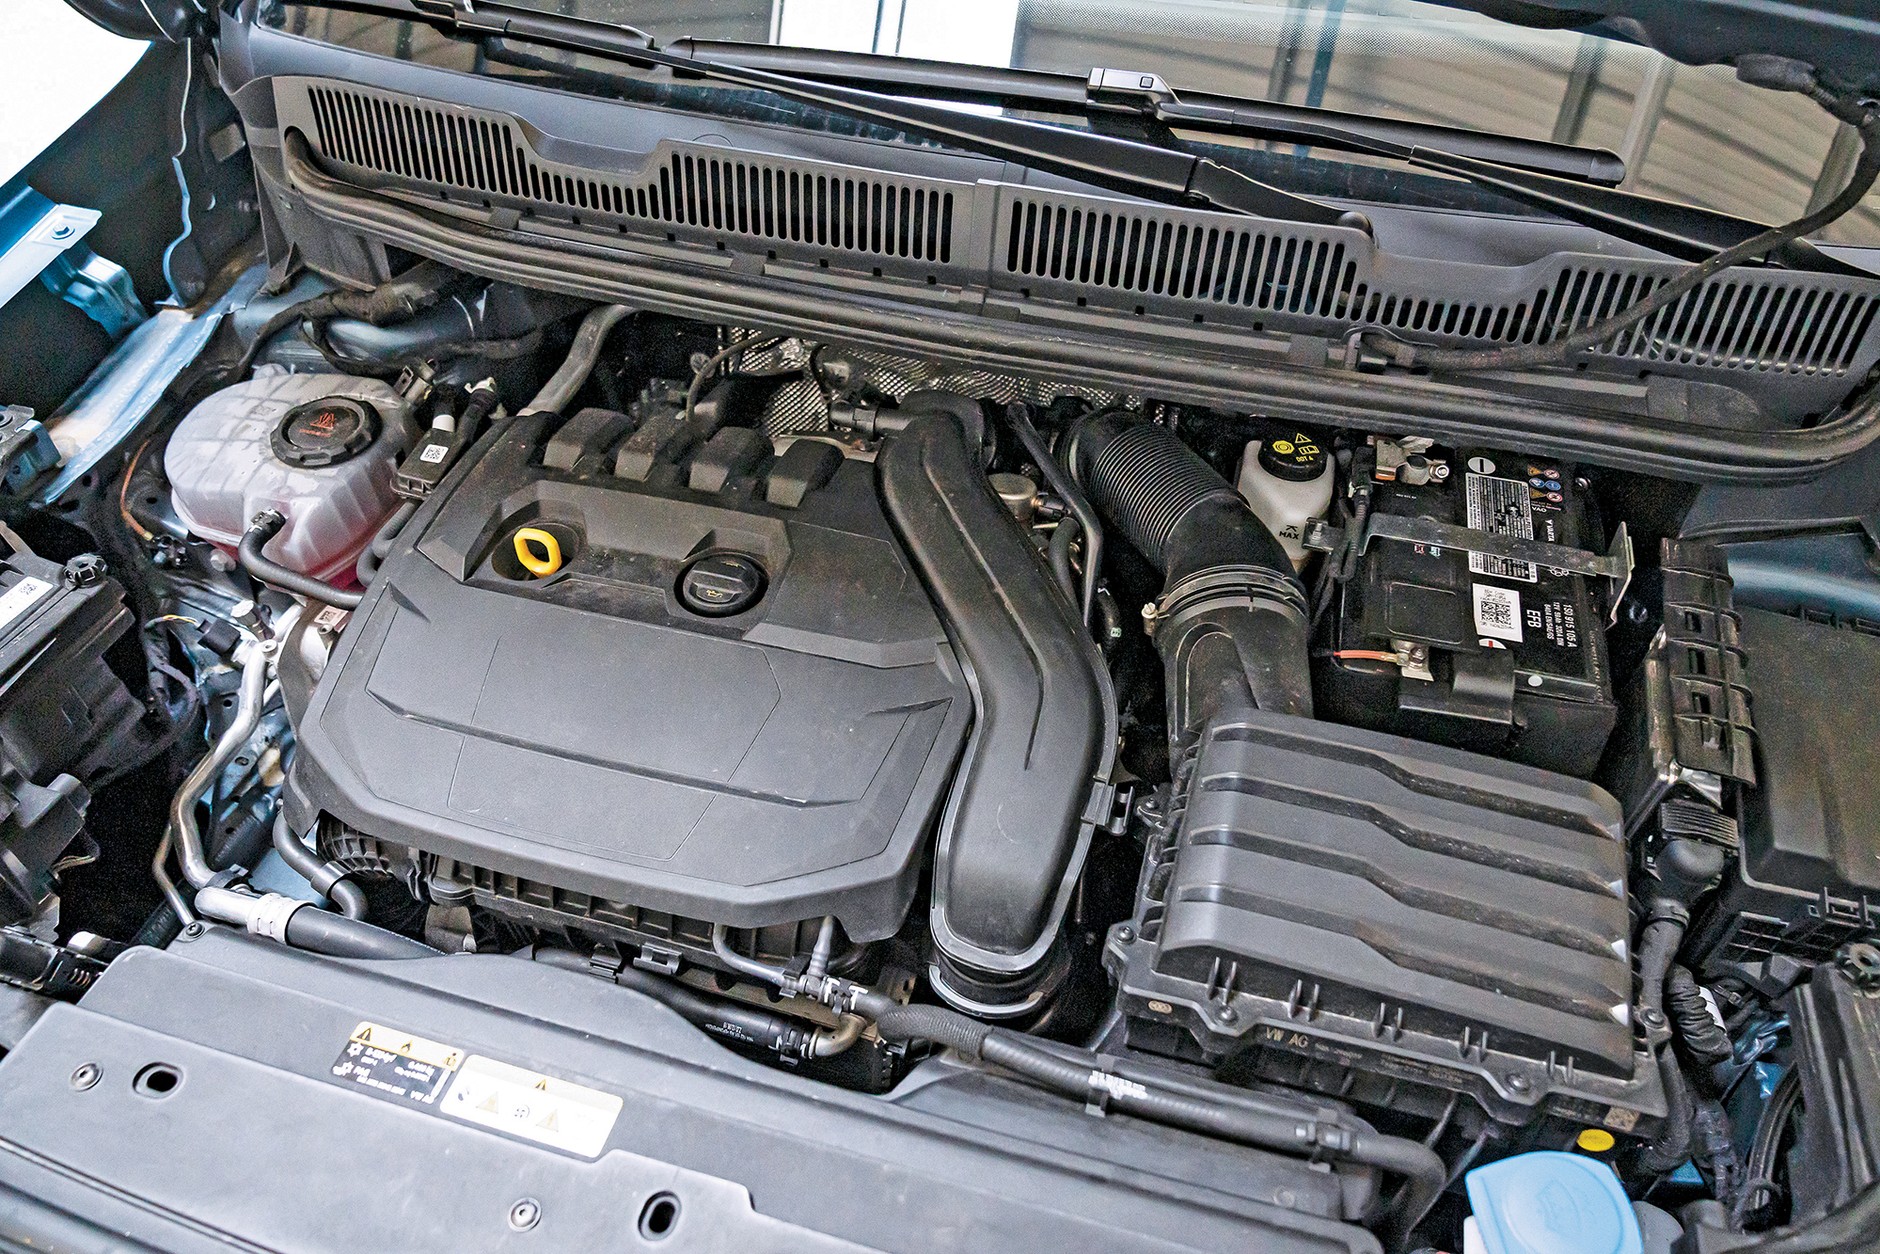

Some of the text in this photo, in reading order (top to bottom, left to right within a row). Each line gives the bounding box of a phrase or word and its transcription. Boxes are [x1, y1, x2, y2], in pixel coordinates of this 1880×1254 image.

[1279, 531, 1299, 540] MAX
[1526, 609, 1542, 629] EFB
[1564, 616, 1575, 629] 915
[1566, 630, 1577, 642] 105
[1265, 1026, 1309, 1049] VW AG
